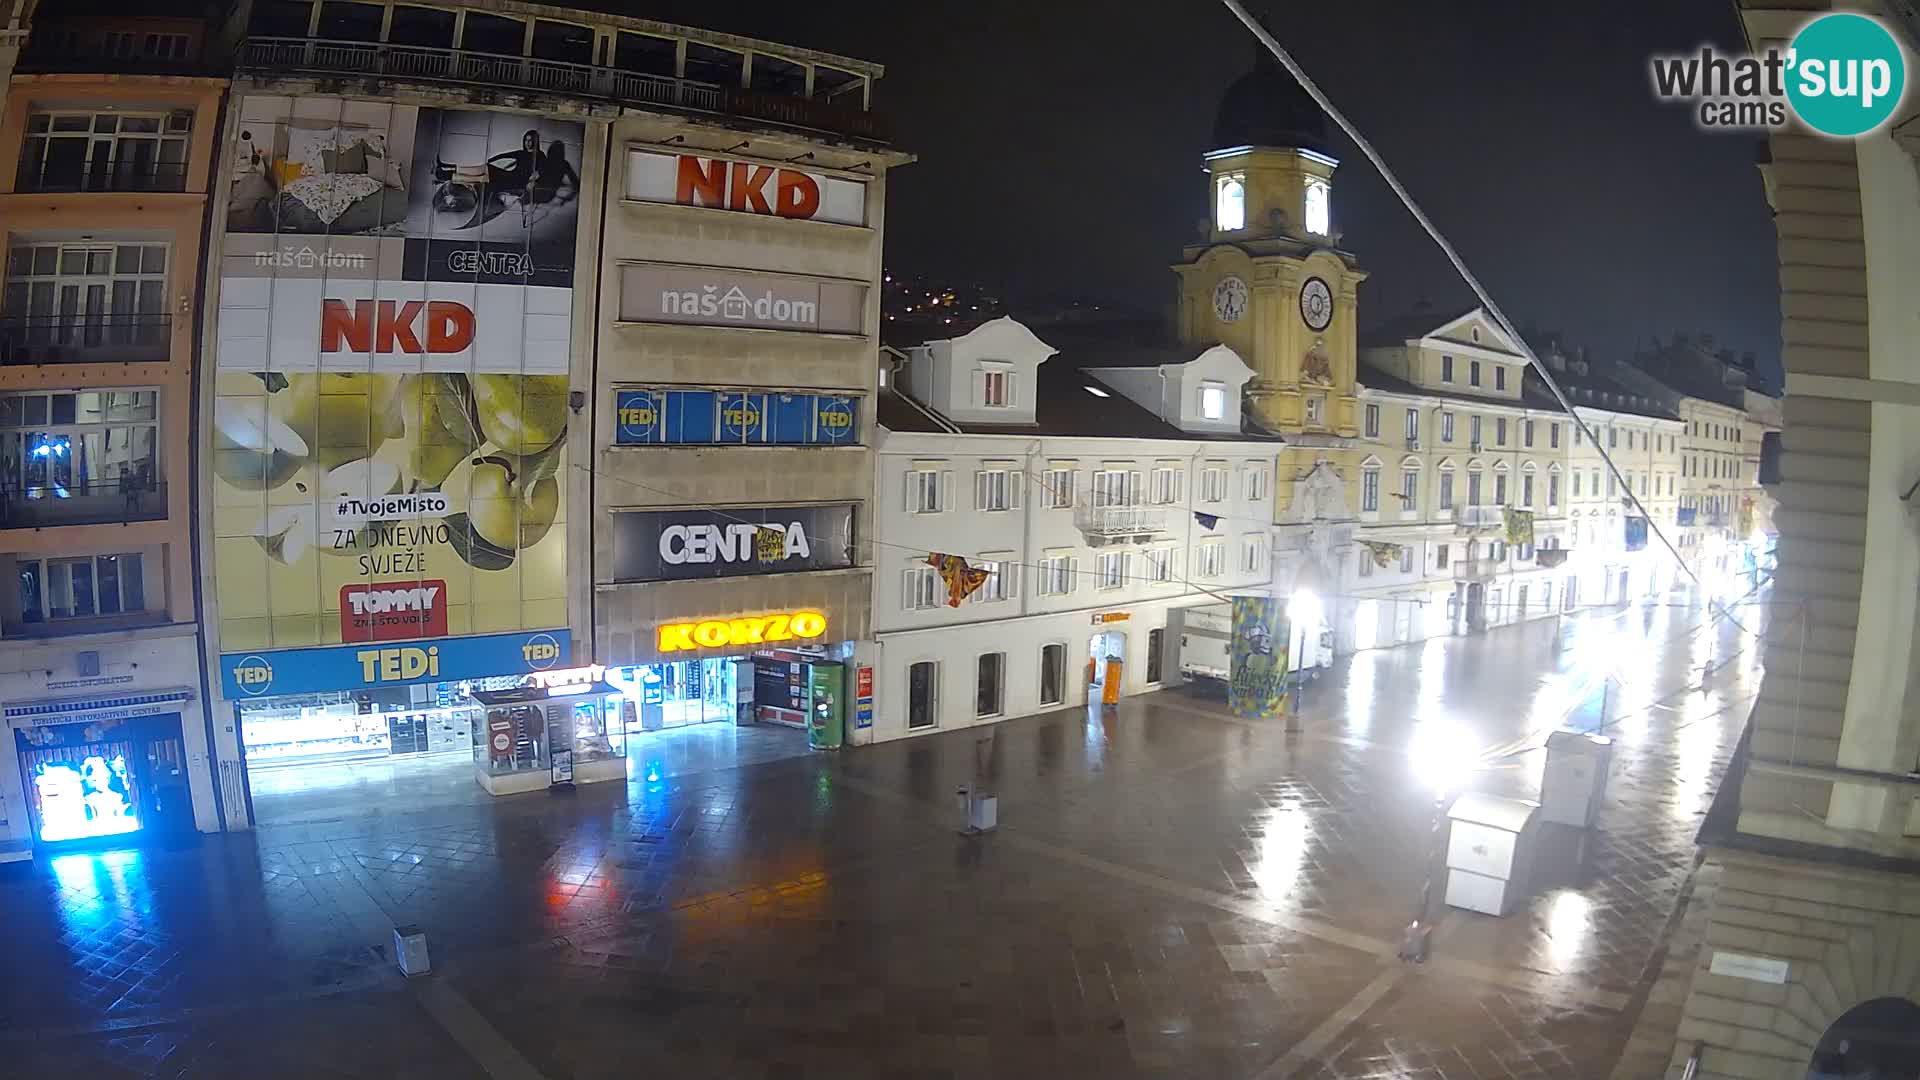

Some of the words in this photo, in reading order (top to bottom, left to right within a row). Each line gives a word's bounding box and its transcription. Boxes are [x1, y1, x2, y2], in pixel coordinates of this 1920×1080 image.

[675, 154, 820, 220] NKD
[319, 247, 365, 268] dom
[447, 250, 535, 276] CENTRA
[661, 284, 718, 317] naš
[754, 290, 817, 324] dom
[320, 299, 477, 354] NKD
[618, 408, 658, 425] TEDi
[338, 497, 446, 517] #TvojeMisto
[333, 529, 357, 550] ZA
[366, 524, 450, 548] DNEVNO
[359, 547, 427, 576] SVJEŽE
[348, 587, 440, 615] TOMMY
[658, 611, 827, 653] KORZO
[357, 645, 440, 683] TEDi
[522, 643, 560, 661] TEDi
[233, 666, 273, 685] TEDi
